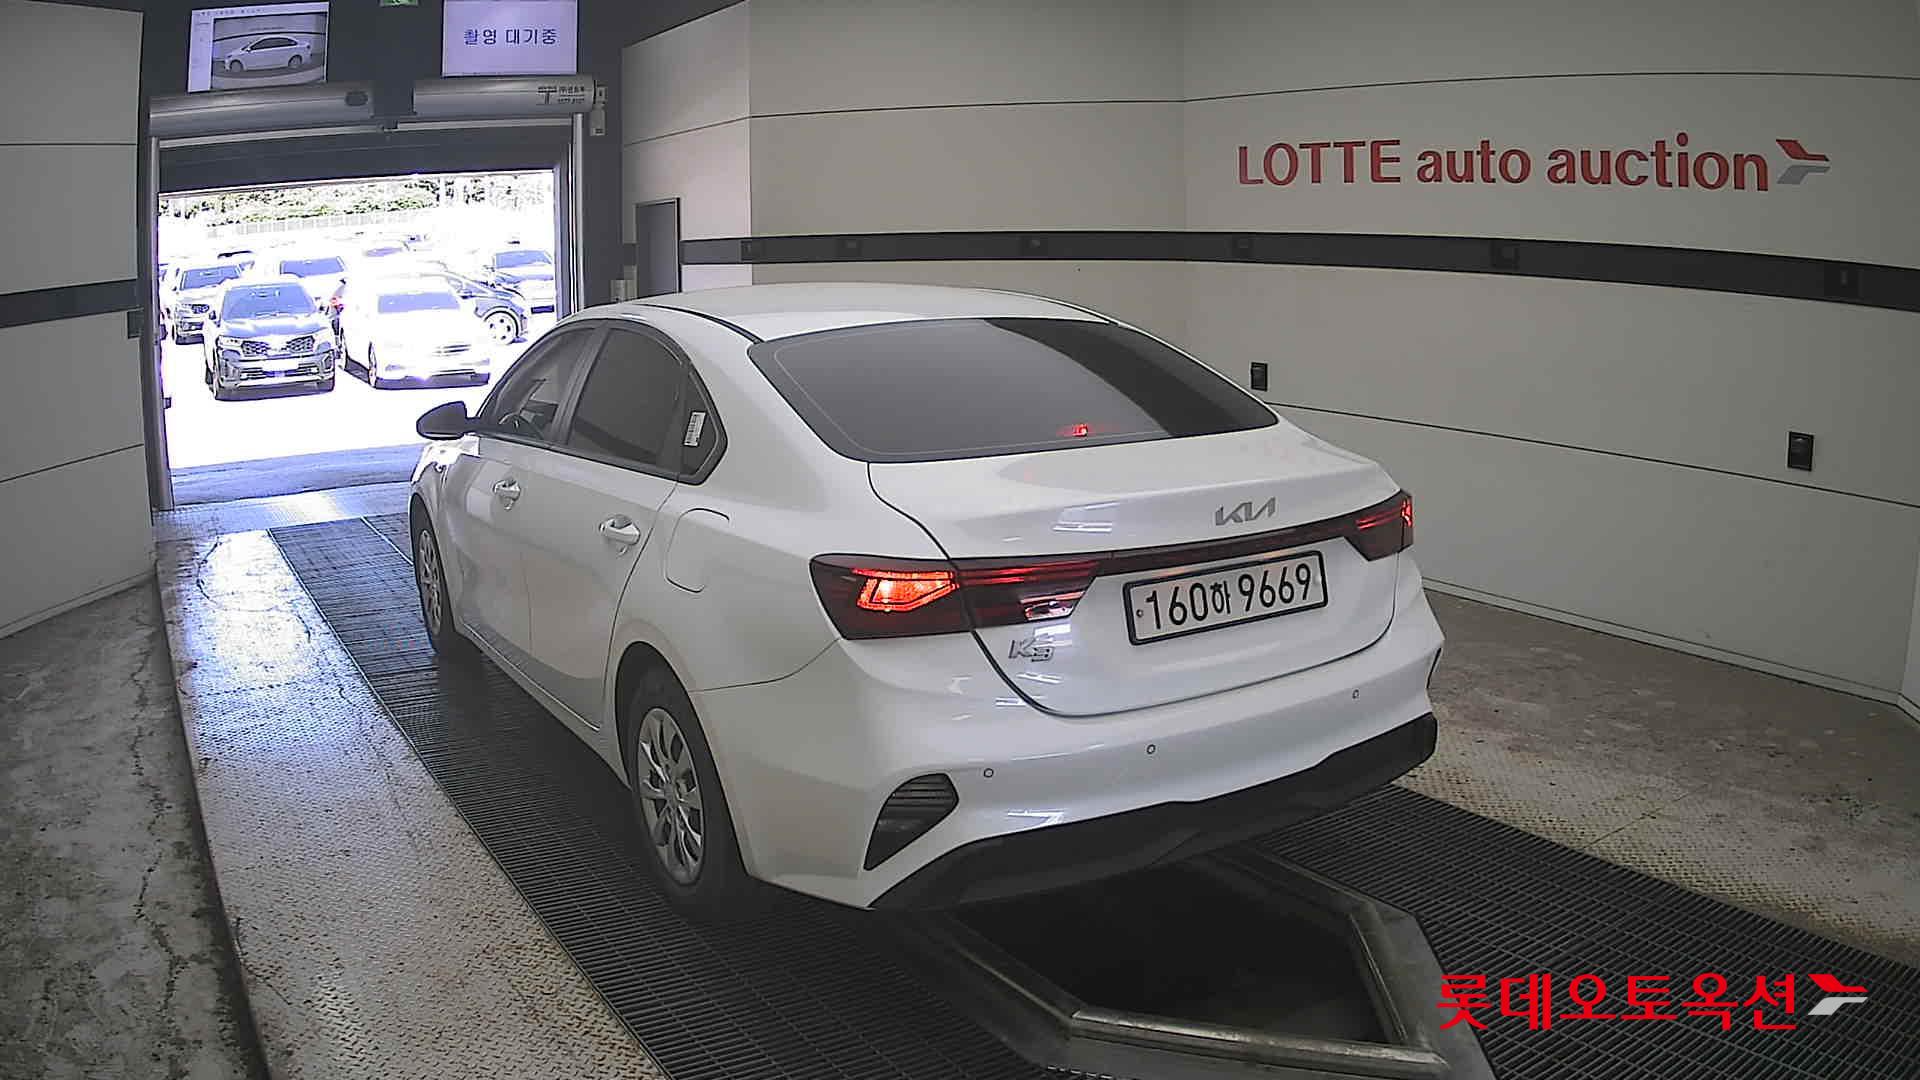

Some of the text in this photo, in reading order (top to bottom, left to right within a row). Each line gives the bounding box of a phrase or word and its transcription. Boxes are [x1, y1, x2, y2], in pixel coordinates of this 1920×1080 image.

[505, 28, 558, 45] 대기중
[1239, 132, 1770, 191] LOTTE auto auction
[1146, 563, 1312, 630] 160하 9669
